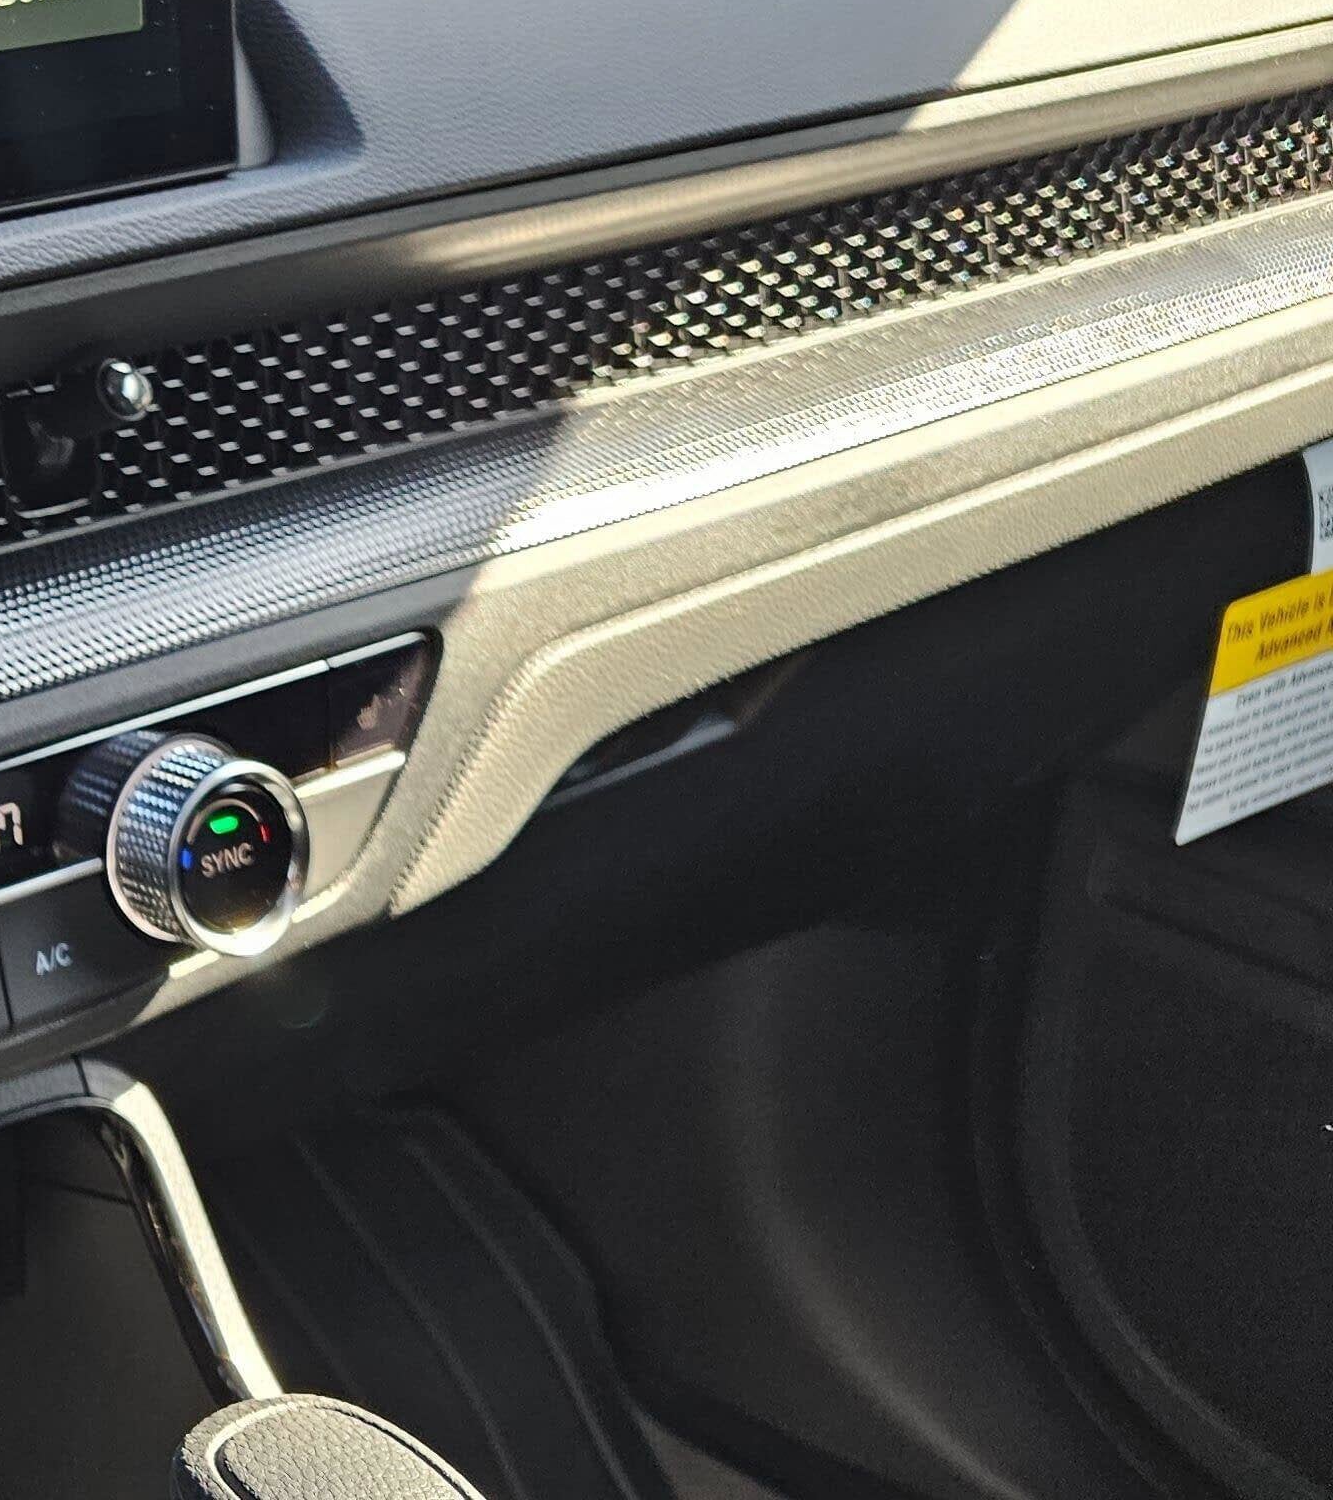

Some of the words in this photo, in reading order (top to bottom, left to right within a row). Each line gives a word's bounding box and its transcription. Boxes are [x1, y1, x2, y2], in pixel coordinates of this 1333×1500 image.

[1259, 598, 1310, 632] Vehicle
[202, 843, 251, 877] SYNC
[36, 943, 72, 976] A/C
